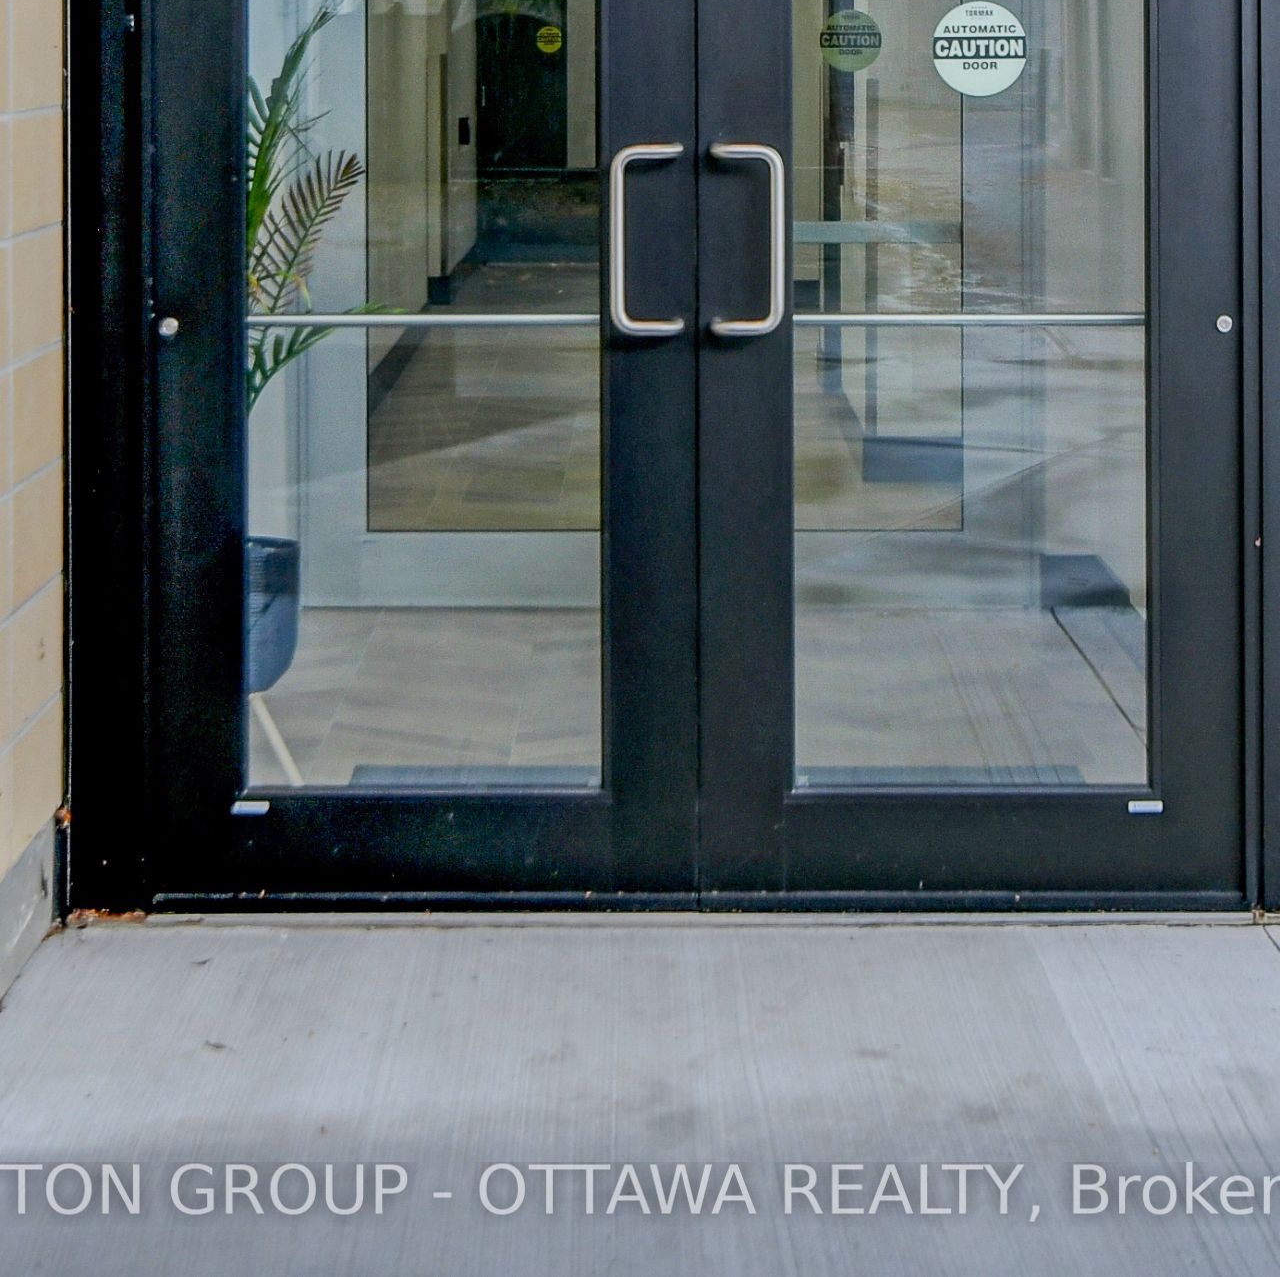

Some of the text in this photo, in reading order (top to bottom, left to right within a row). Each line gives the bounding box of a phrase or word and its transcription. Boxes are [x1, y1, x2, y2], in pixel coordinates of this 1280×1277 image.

[943, 25, 1017, 34] AUTOMATIC
[821, 34, 880, 46] CAUTION
[935, 39, 1024, 57] CAUTION
[962, 62, 998, 70] DOOR
